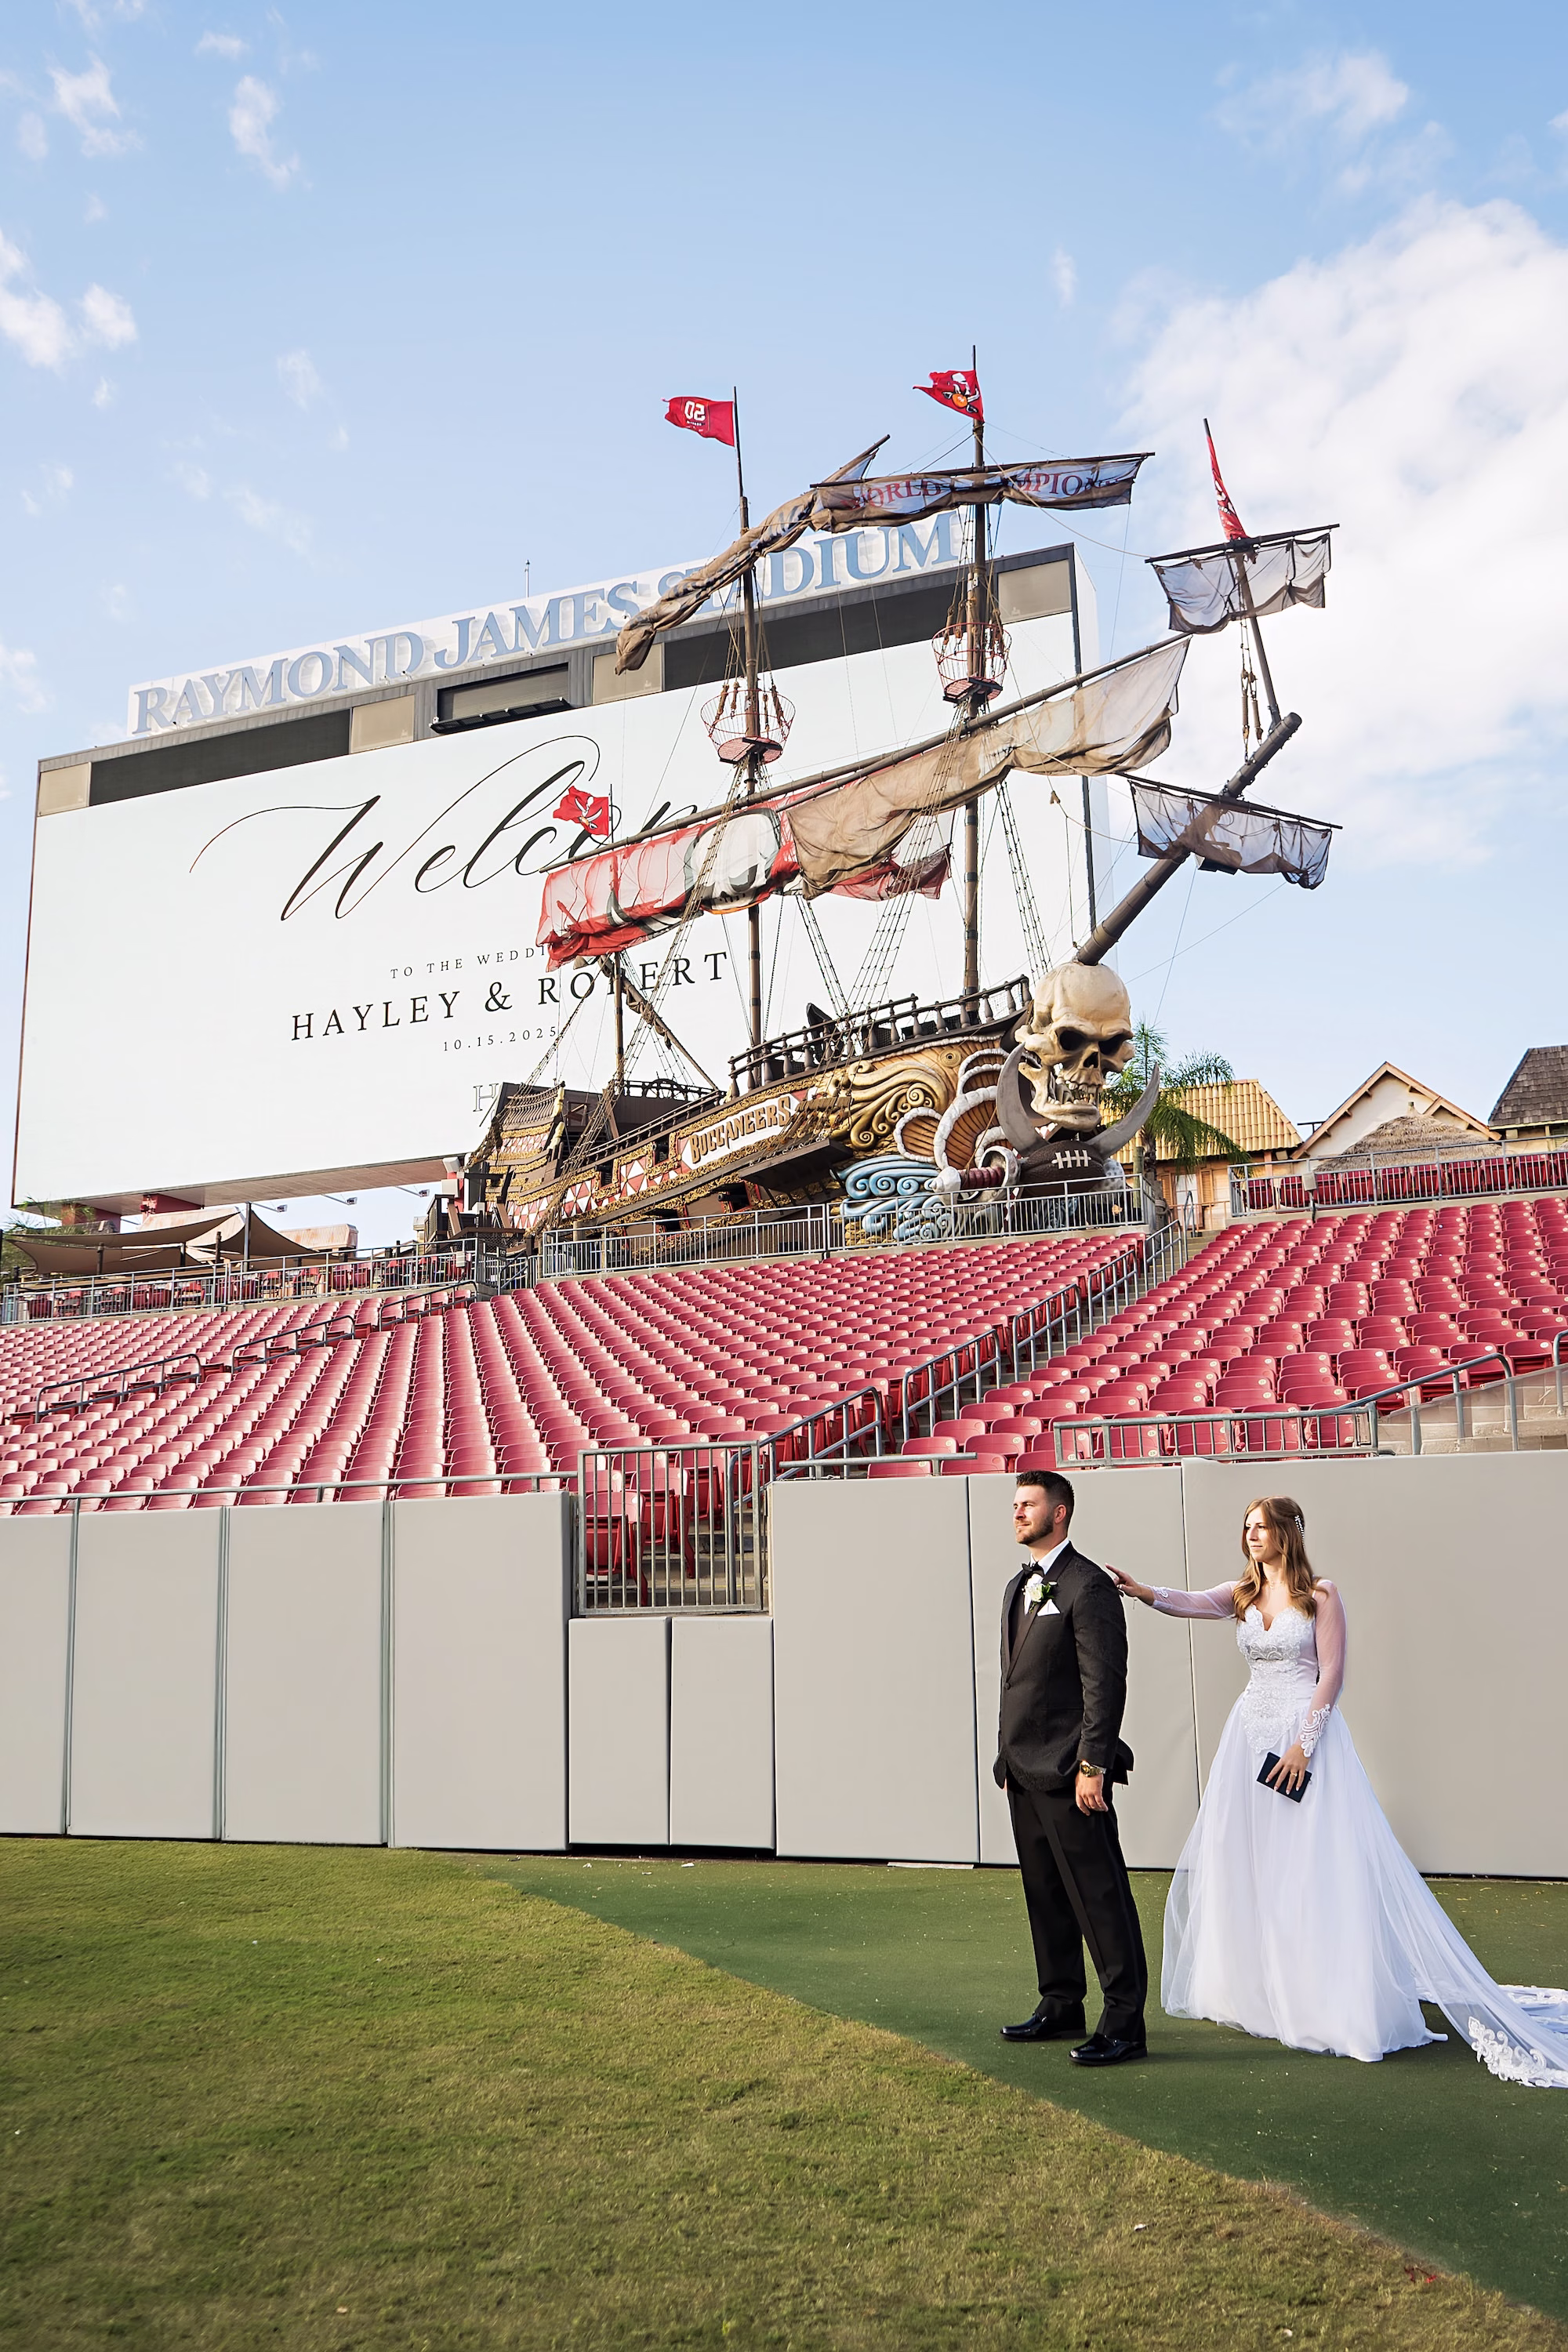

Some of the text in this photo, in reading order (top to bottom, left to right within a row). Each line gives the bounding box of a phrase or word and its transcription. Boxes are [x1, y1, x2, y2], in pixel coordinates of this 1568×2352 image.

[133, 511, 958, 735] RAYMOND JAMES DIUM
[390, 946, 545, 979] TO THE WEDDI
[291, 991, 461, 1041] HAYLEY
[485, 982, 513, 1011] &
[443, 1025, 557, 1051] 10.15.2025
[688, 1096, 791, 1164] BUCCANEERS
